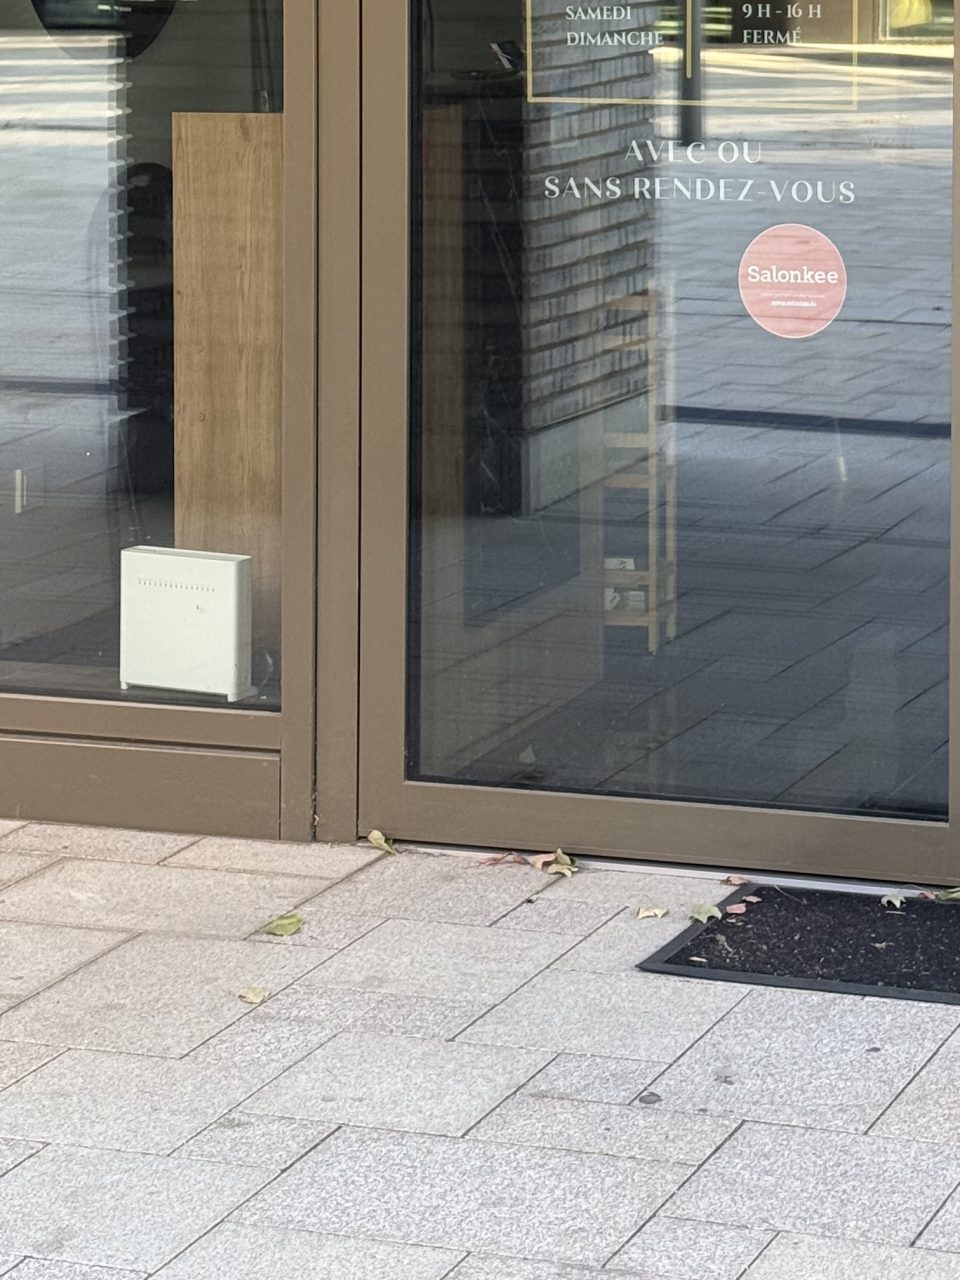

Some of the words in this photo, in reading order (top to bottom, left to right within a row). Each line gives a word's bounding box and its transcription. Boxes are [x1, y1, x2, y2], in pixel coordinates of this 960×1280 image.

[566, 5, 631, 20] SAMEDI
[566, 31, 664, 46] DIMANCHE
[743, 27, 802, 44] FERMÉ
[625, 139, 705, 164] AVEC
[717, 141, 761, 163] OU
[544, 176, 621, 199] SANS
[747, 266, 839, 284] Salonkee
